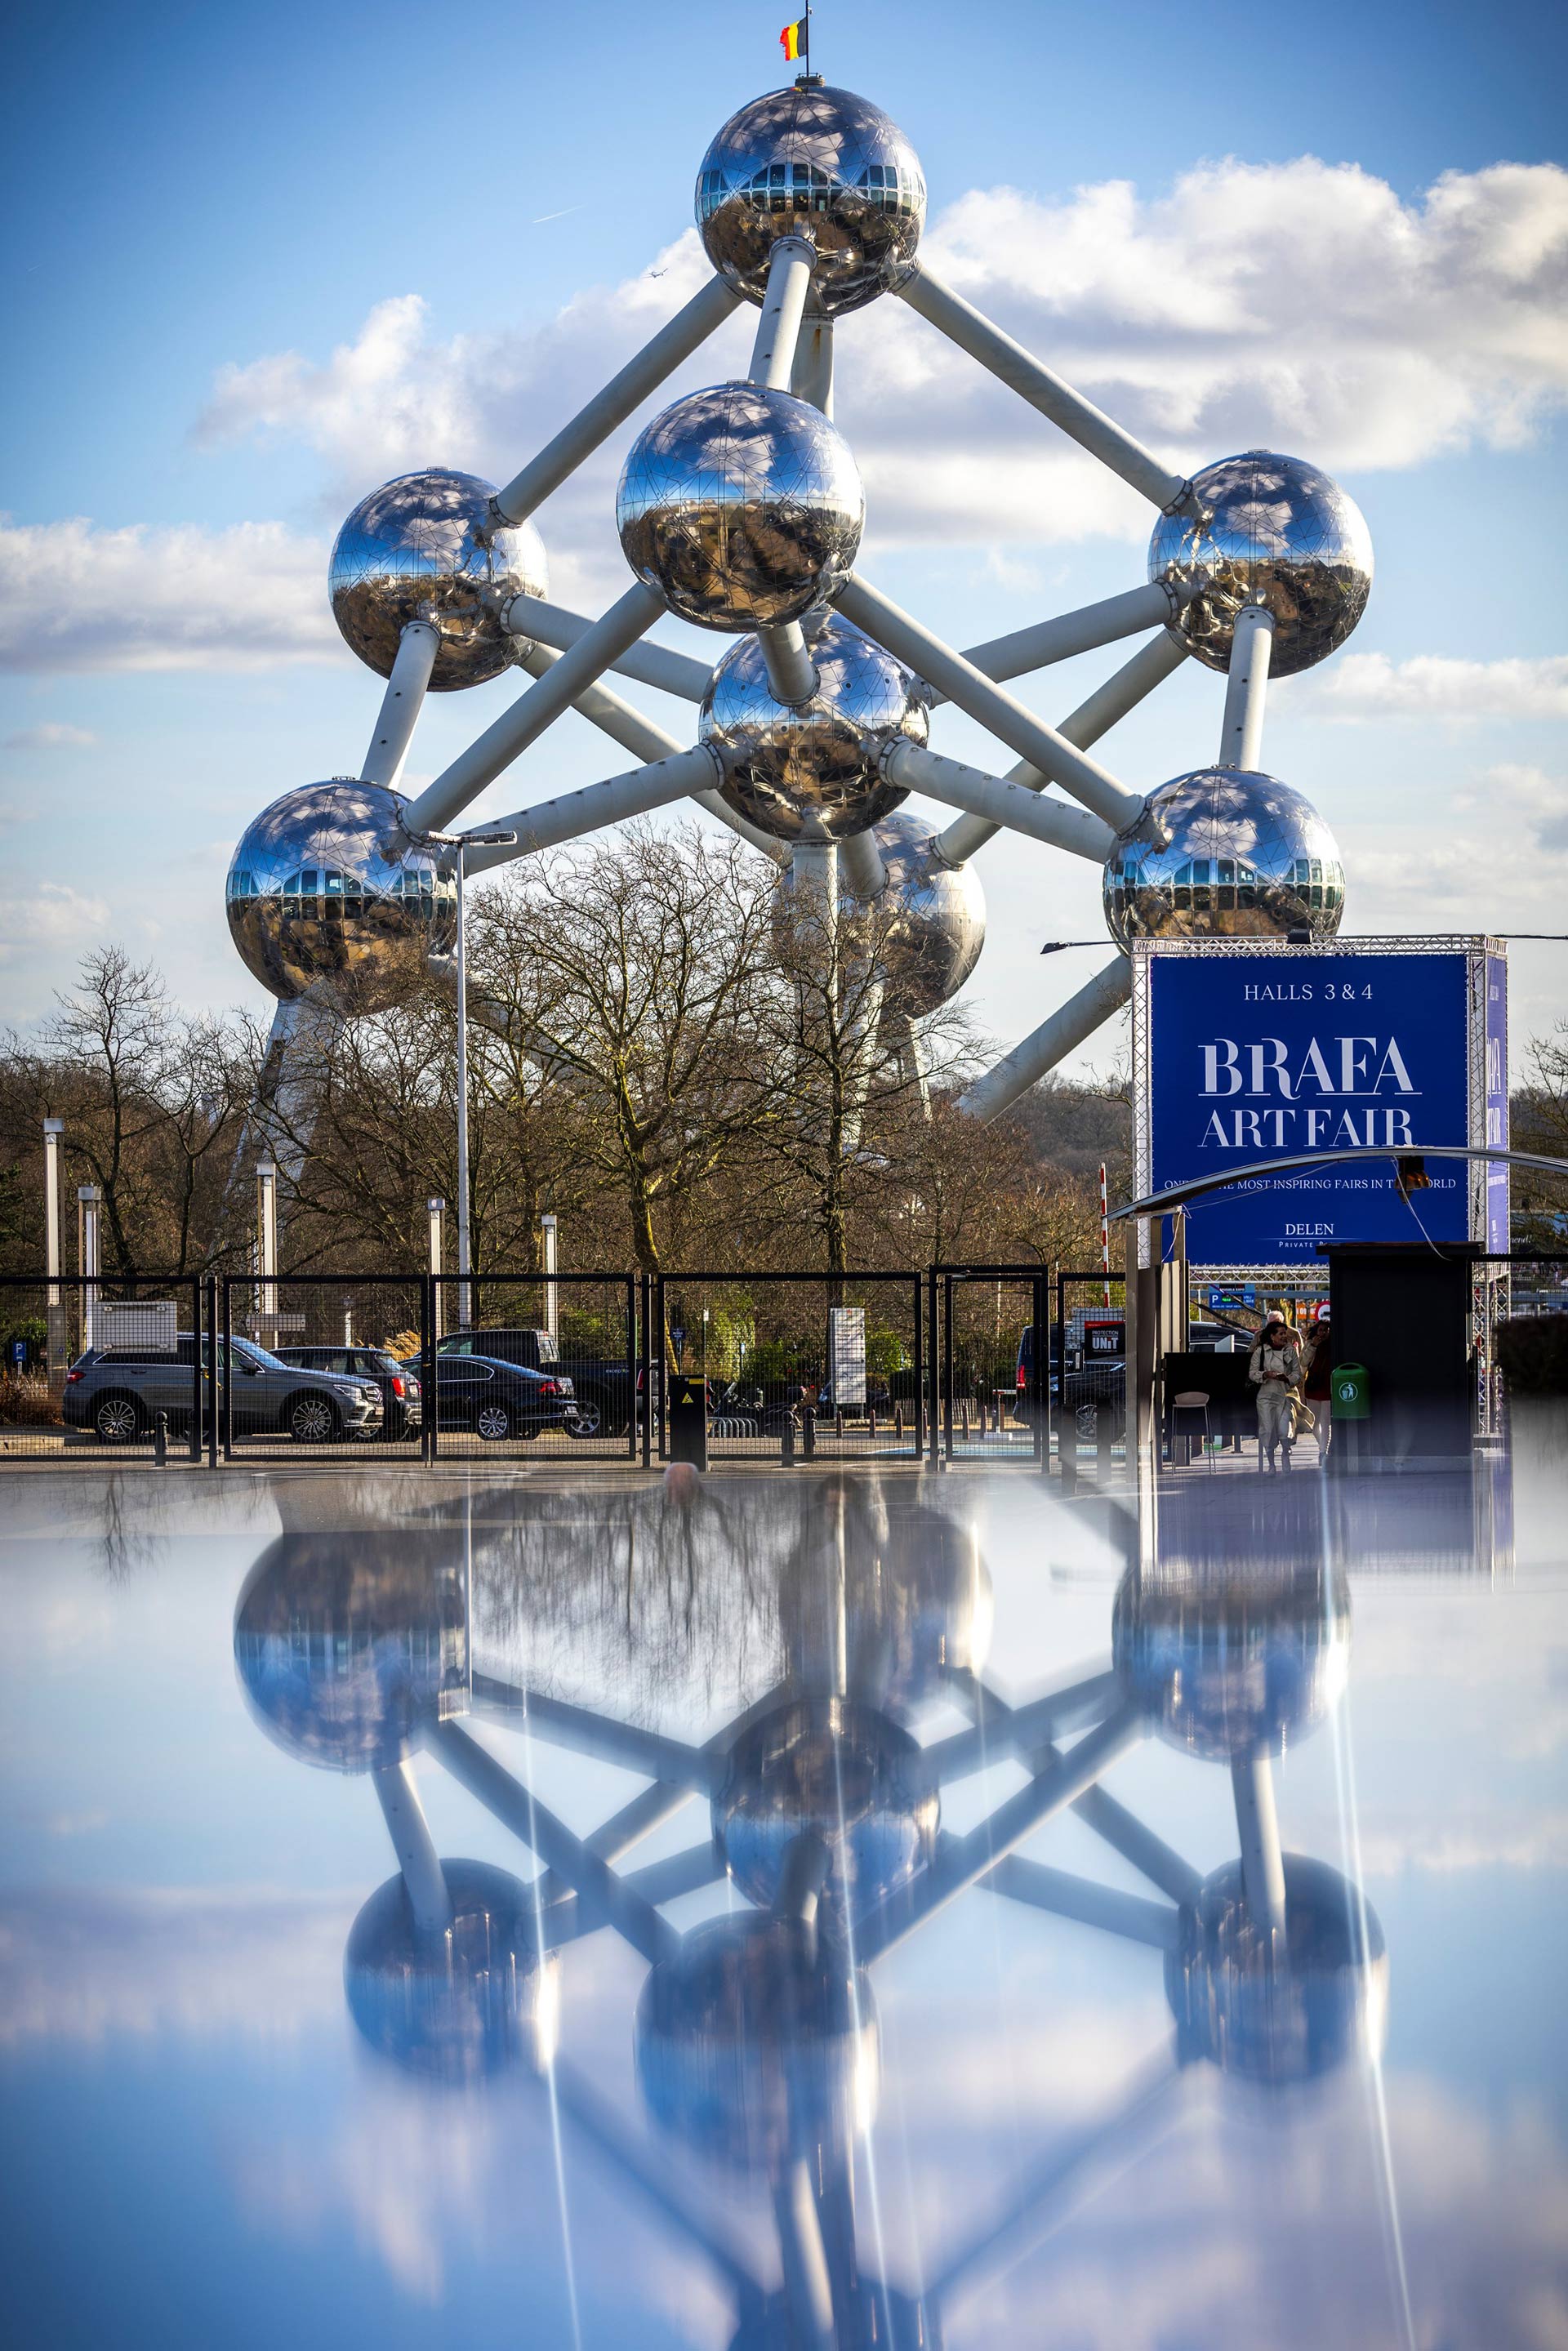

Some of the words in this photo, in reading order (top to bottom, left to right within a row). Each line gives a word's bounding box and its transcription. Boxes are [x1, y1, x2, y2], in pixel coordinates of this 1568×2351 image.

[1244, 983, 1313, 1000] HALLS
[1197, 1035, 1423, 1100] BRAFA
[1197, 1108, 1296, 1147] ART
[1303, 1108, 1418, 1147] FAIR
[1237, 1179, 1271, 1189] MOST
[1273, 1179, 1332, 1189] INSPIRING
[1334, 1179, 1369, 1189] FAIRS
[1371, 1179, 1383, 1189] IN
[1285, 1223, 1334, 1236] DELEN
[1212, 1294, 1218, 1303] P
[16, 1342, 24, 1354] P
